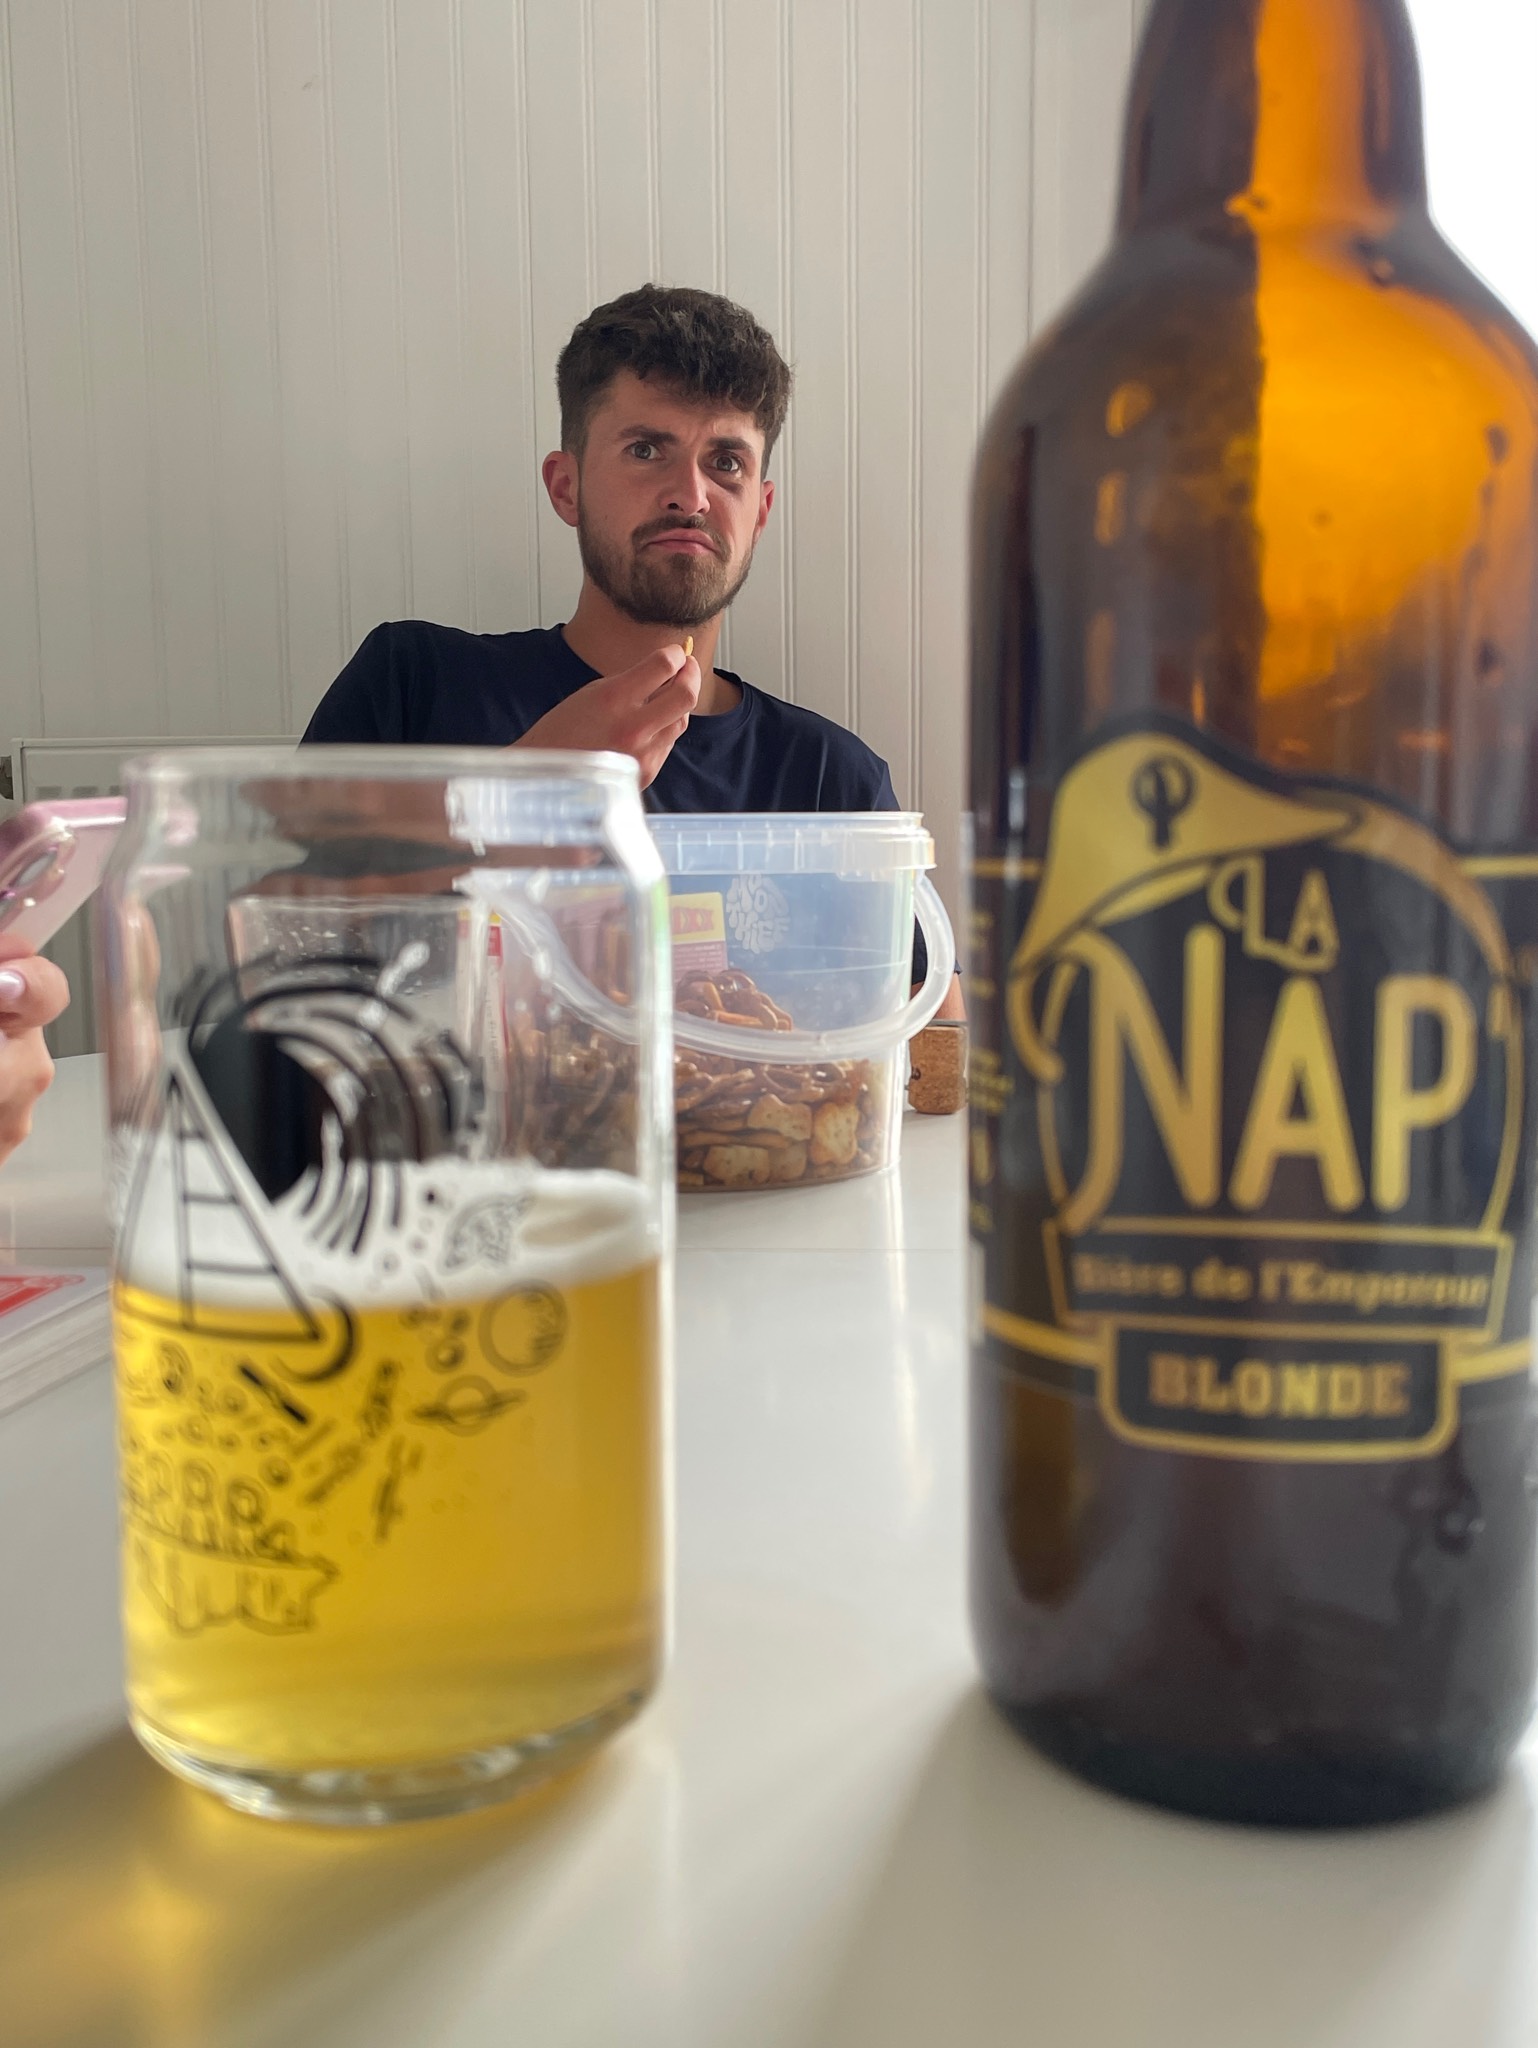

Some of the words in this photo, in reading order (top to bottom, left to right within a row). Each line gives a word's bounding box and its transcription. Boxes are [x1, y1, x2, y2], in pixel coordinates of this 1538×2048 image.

[1208, 857, 1340, 971] LA
[1042, 924, 1478, 1235] NAP
[1191, 1256, 1252, 1301] de
[1150, 1353, 1411, 1421] BLONDE
